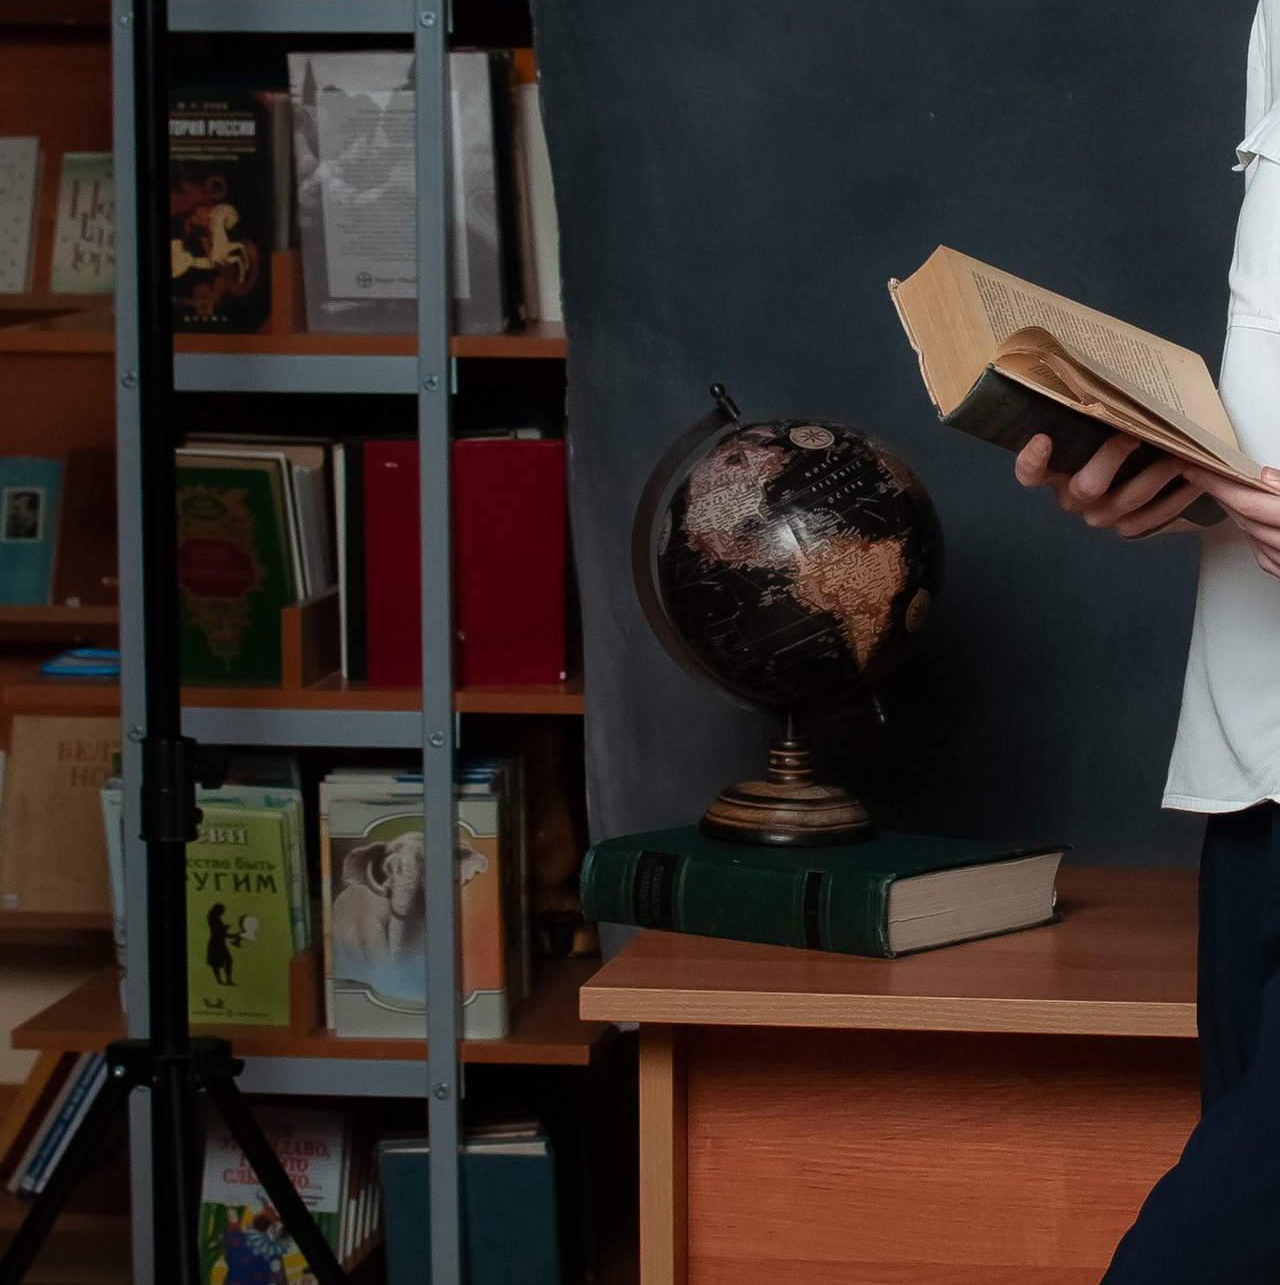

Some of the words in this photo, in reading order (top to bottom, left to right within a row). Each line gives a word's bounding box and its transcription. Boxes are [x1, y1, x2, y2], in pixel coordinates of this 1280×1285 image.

[207, 120, 256, 136] РОССИИ
[235, 856, 275, 871] быть
[187, 871, 277, 893] УГИМ
